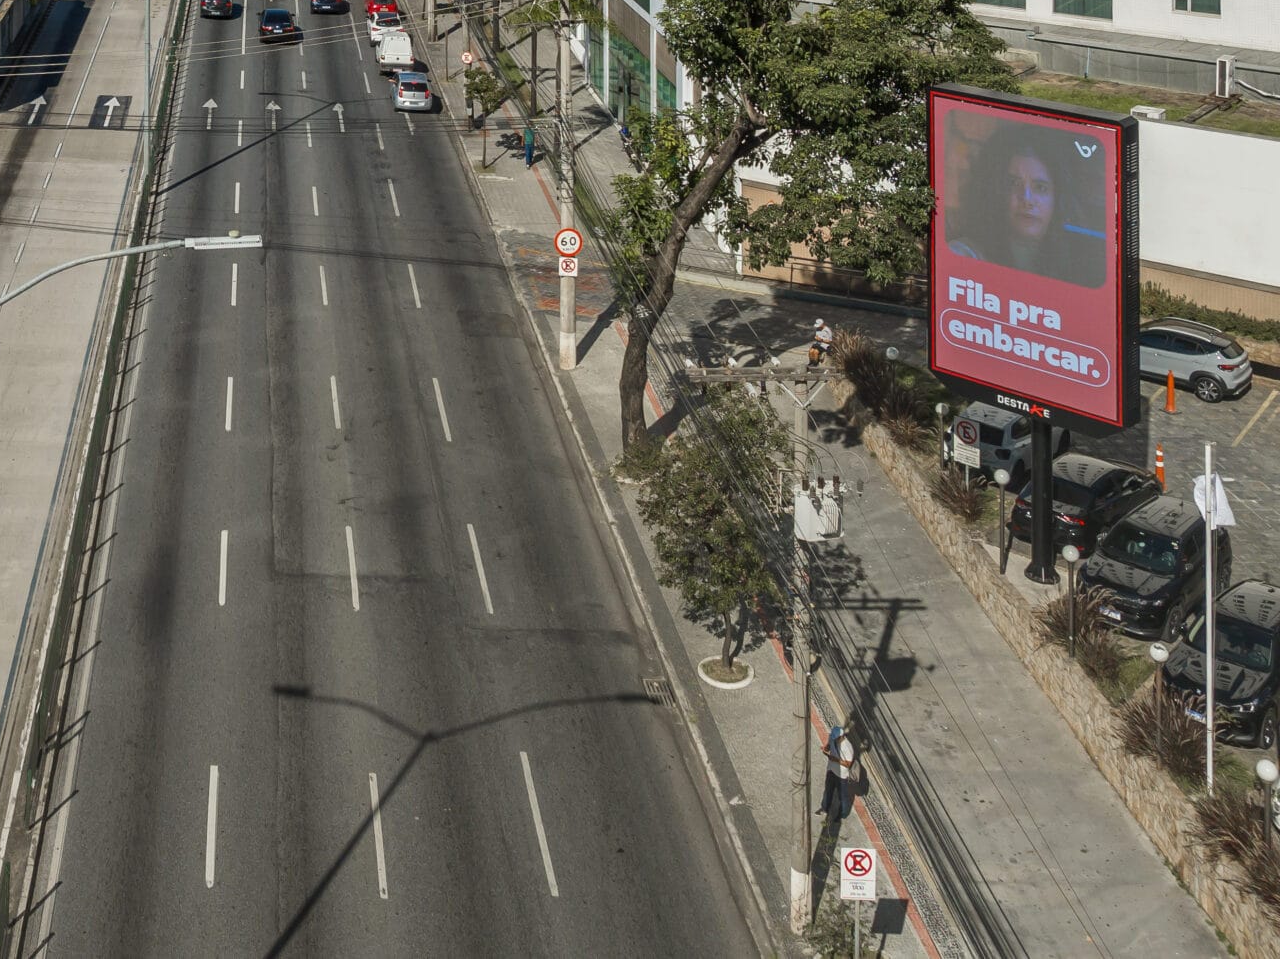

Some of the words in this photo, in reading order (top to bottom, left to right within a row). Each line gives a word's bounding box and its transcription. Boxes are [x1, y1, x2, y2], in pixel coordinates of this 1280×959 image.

[561, 236, 577, 247] 60
[948, 276, 1001, 314] Fila
[1009, 299, 1061, 330] pra
[948, 318, 1101, 379] embarcar.
[997, 394, 1050, 419] DESTAKE
